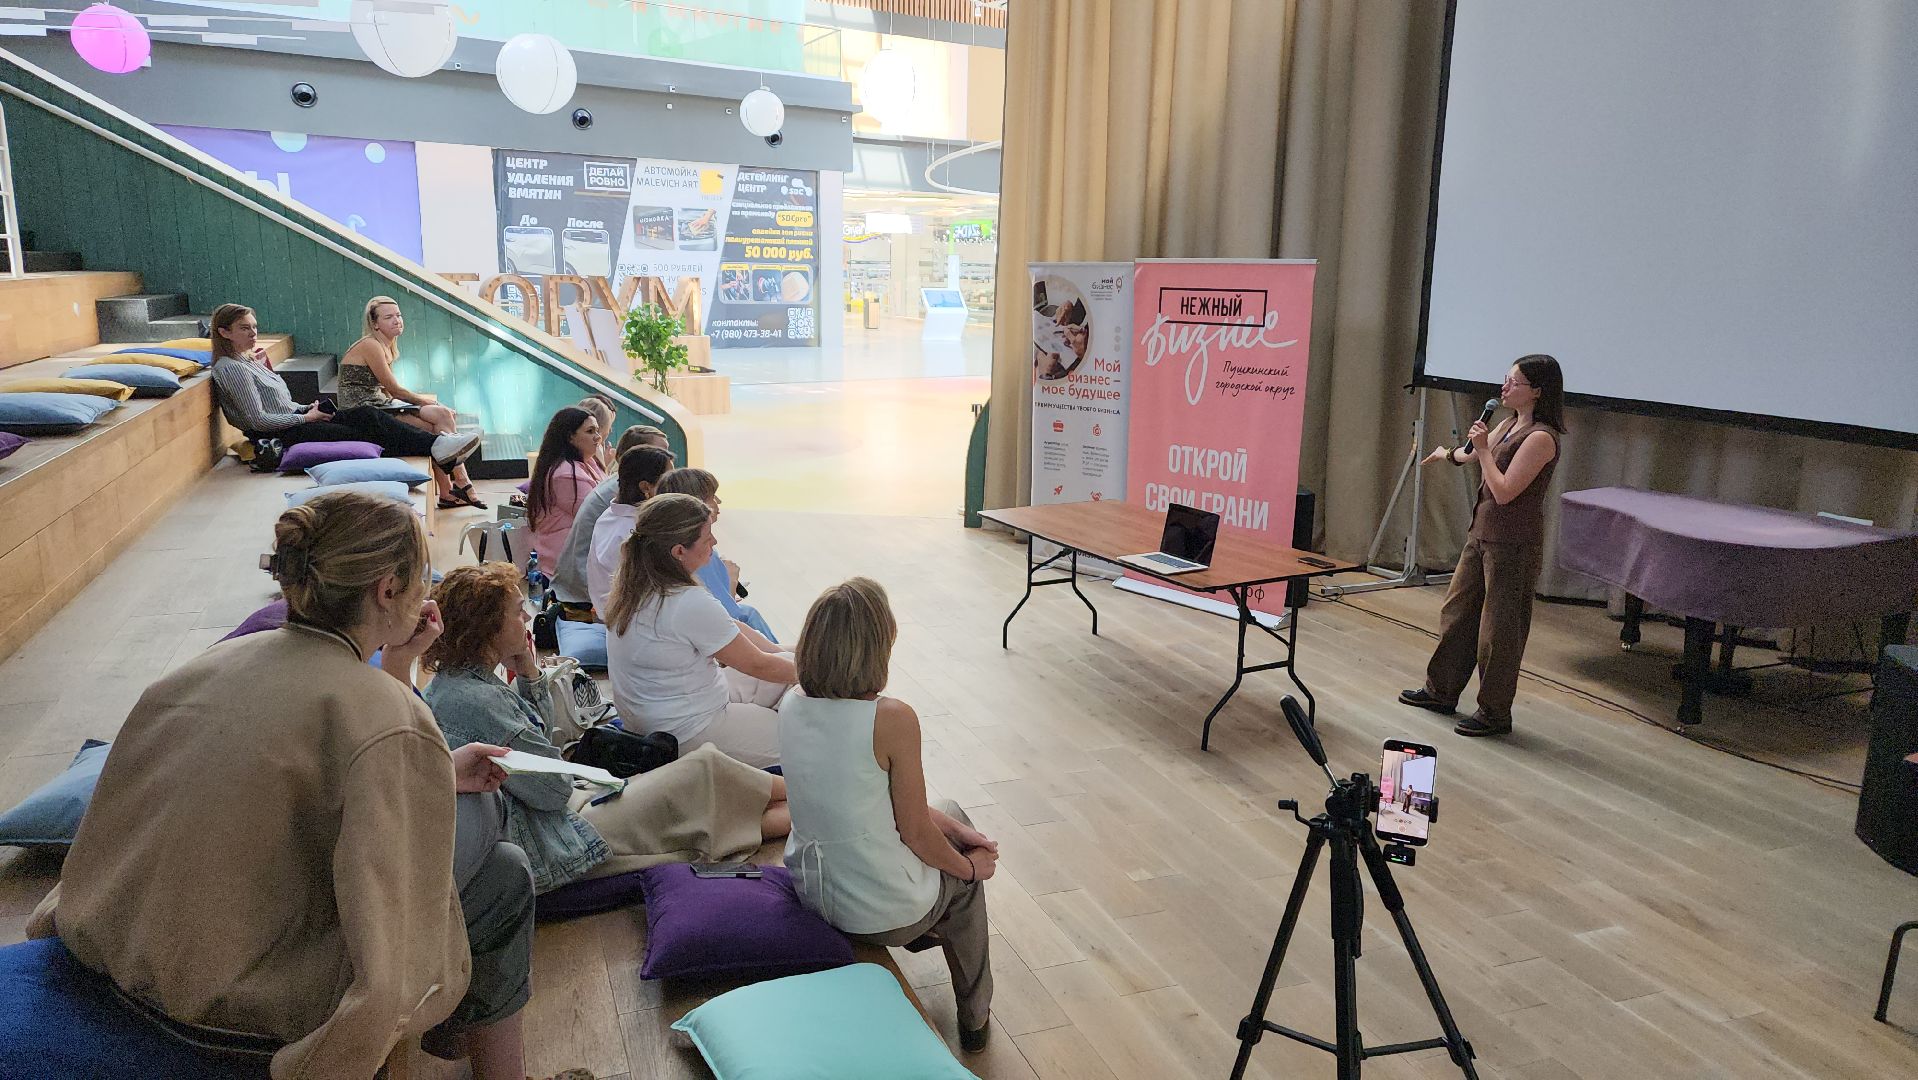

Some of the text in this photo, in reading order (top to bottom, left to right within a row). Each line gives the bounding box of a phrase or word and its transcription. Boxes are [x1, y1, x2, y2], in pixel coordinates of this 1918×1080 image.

[505, 156, 548, 169] ЦЕНТР
[588, 166, 624, 177] ДЕЛАЙ
[644, 166, 698, 177] АВТОМОЙКА
[736, 171, 789, 183] ДЕТЕЙЛИНГ
[506, 171, 574, 186] УДАЛЕНИЯ
[590, 176, 625, 187] РОВНО
[636, 177, 698, 188] MALEVICH ART
[508, 187, 562, 200] ВМЯТИН
[737, 183, 767, 193] ЦЕНТР
[519, 215, 538, 226] До
[566, 217, 604, 229] После
[744, 245, 814, 261] 50 000 руб.
[436, 272, 700, 336] ОРУМ
[1180, 293, 1243, 317] НЕЖНЫЙ
[710, 329, 782, 340] +7 (980) 473-38-41
[1094, 357, 1121, 373] Мой
[1222, 360, 1290, 379] Пушкинский
[1067, 372, 1110, 386] бизнес
[1041, 384, 1121, 400] мое будущее
[1215, 381, 1296, 401] городской округ
[1168, 444, 1248, 484] ОТКРОЙ
[1145, 482, 1270, 531] СВОИ ГРАНИ
